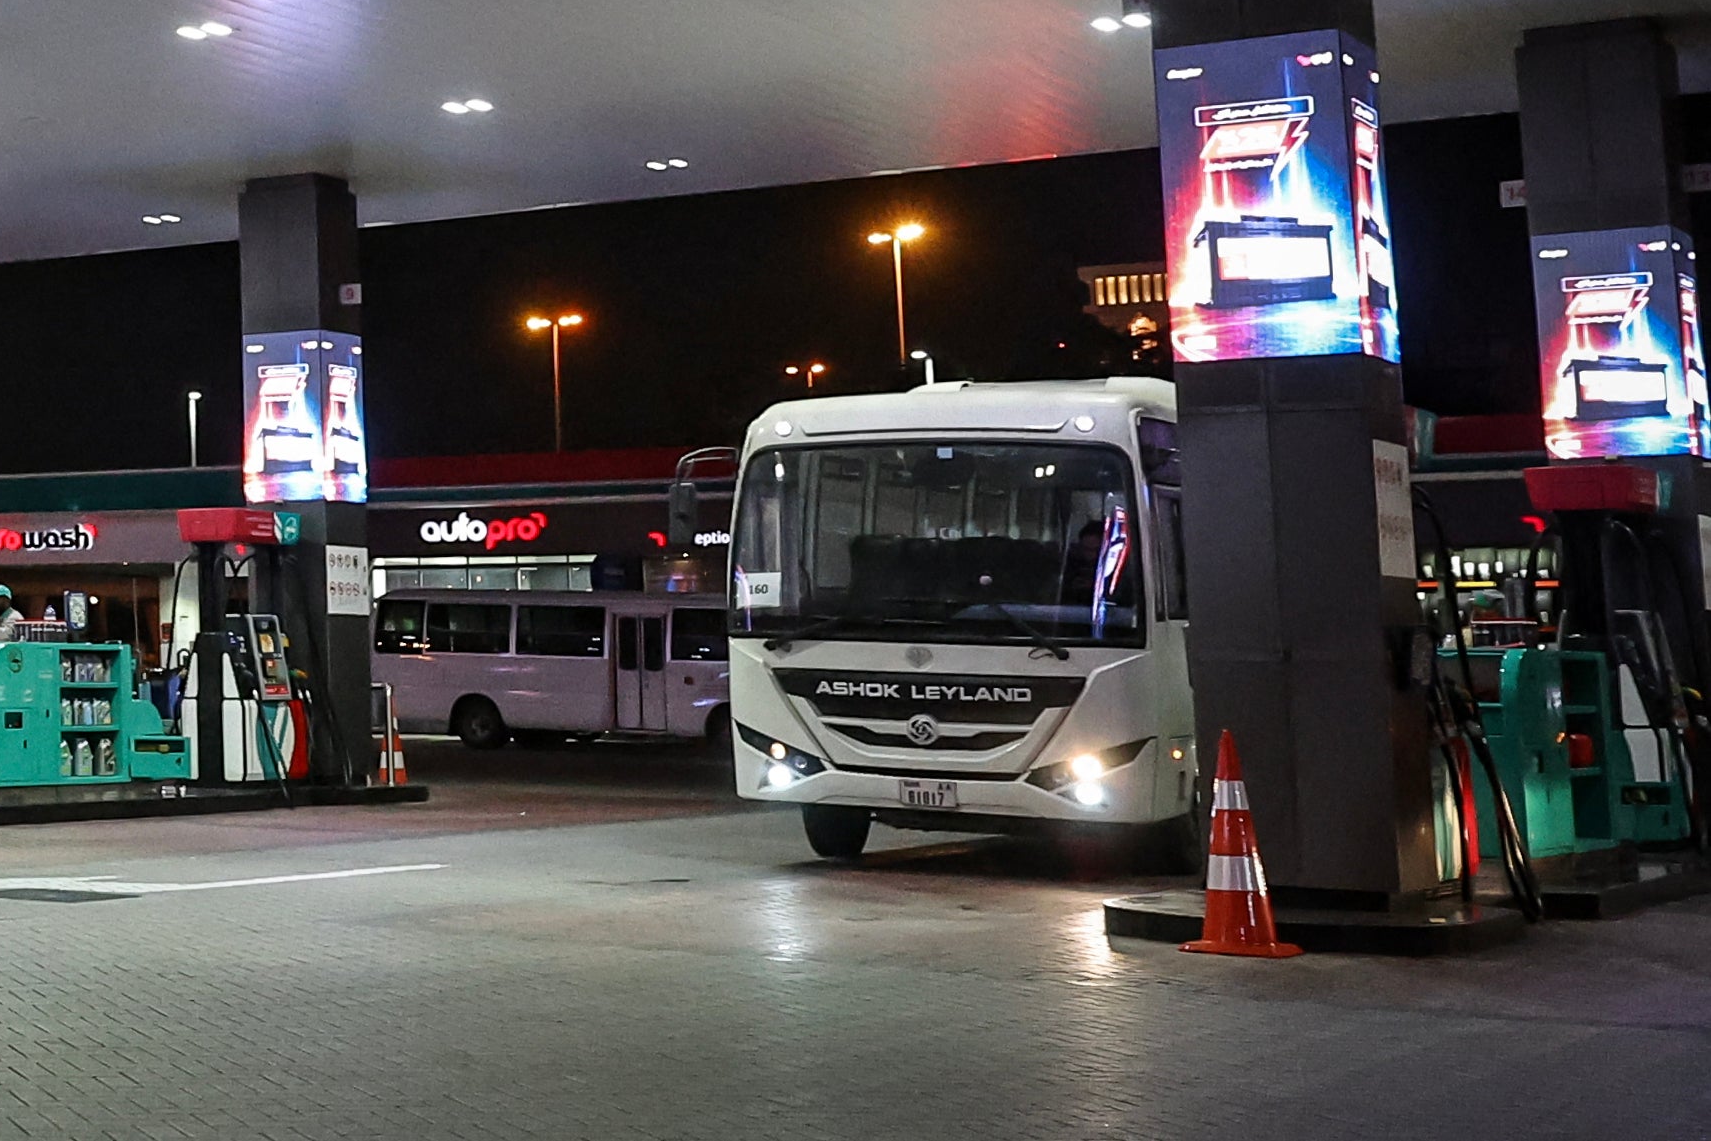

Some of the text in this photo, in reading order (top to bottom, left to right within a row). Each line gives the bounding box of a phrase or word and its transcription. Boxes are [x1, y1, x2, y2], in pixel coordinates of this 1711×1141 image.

[420, 512, 543, 550] autopro
[816, 681, 1032, 702] ASHOK LEYLAND
